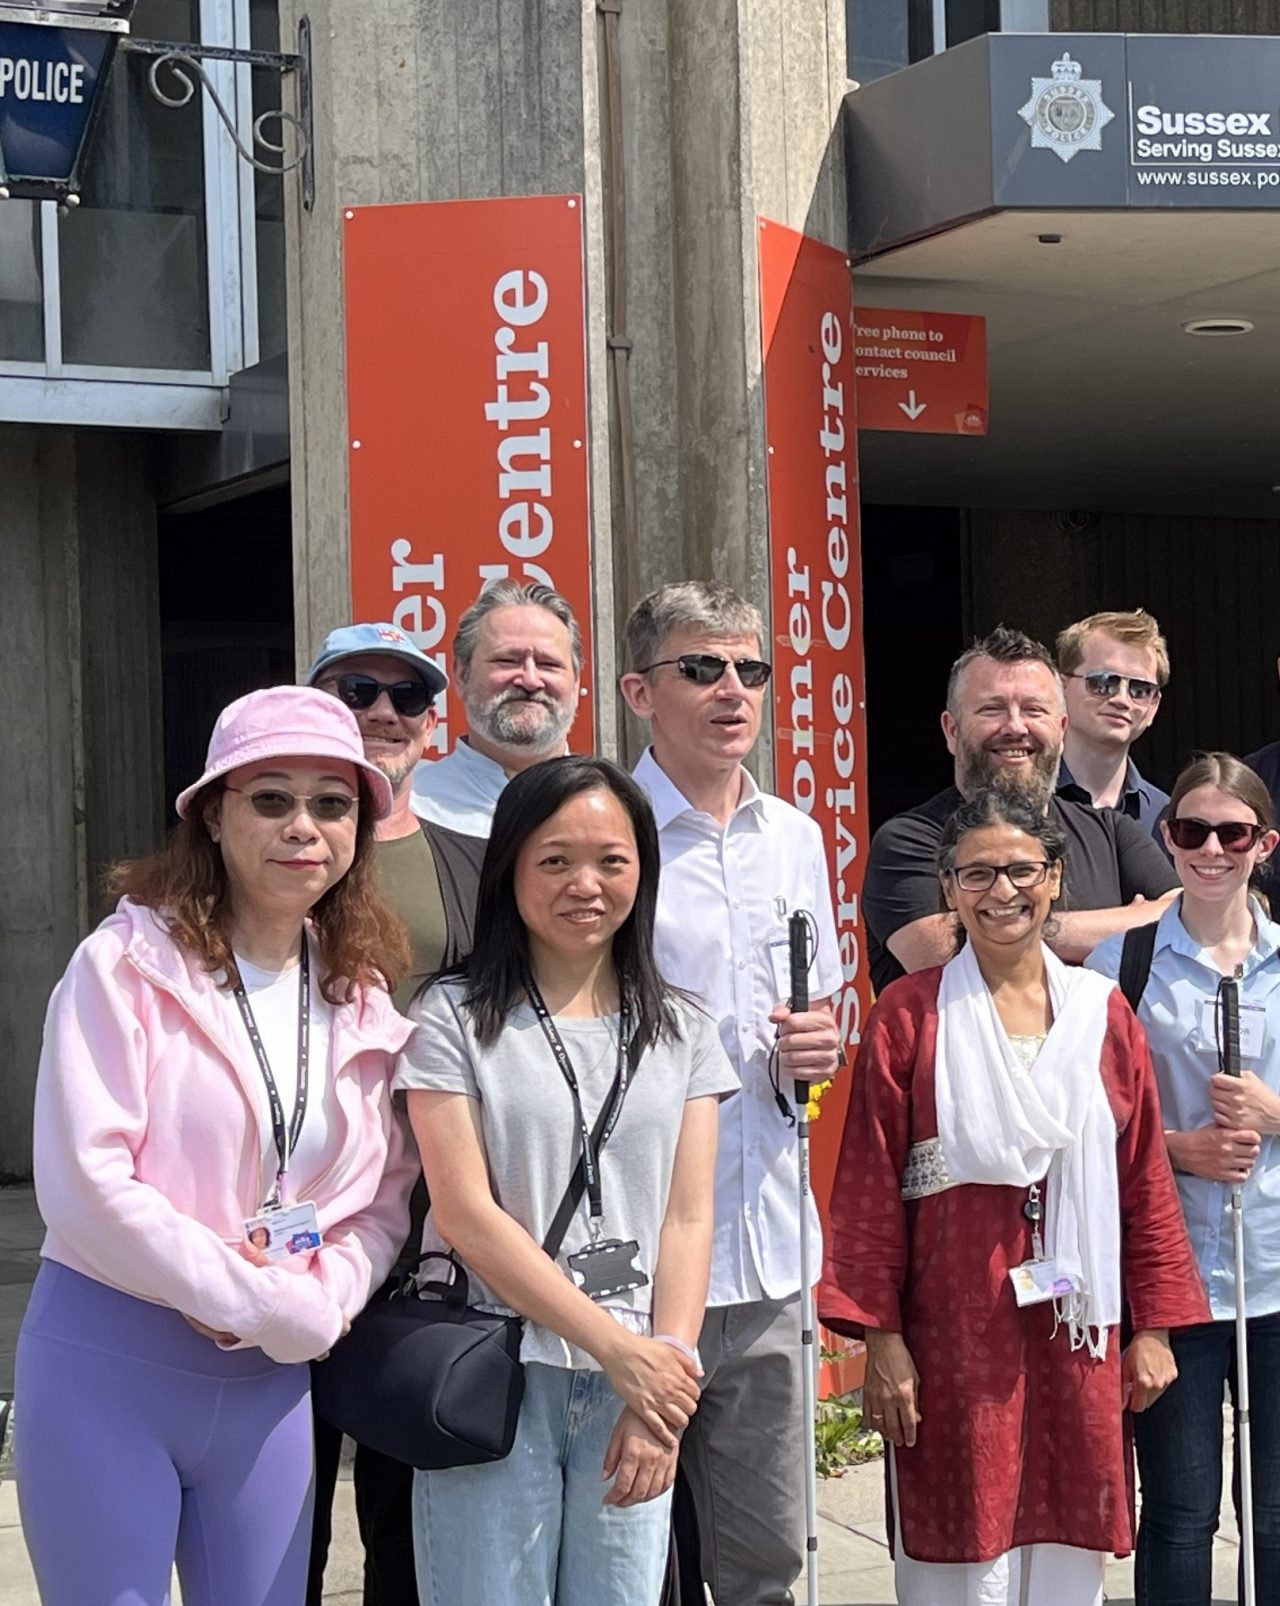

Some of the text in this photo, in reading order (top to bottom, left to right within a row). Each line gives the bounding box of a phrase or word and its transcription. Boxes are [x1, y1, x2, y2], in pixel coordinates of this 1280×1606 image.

[0, 57, 84, 104] POLICE
[1136, 105, 1272, 136] Sussex
[1136, 139, 1212, 161] Serving
[853, 325, 944, 342] ree phone to
[855, 346, 957, 362] ontact council
[855, 364, 908, 378] ervices
[819, 310, 851, 651] Centre
